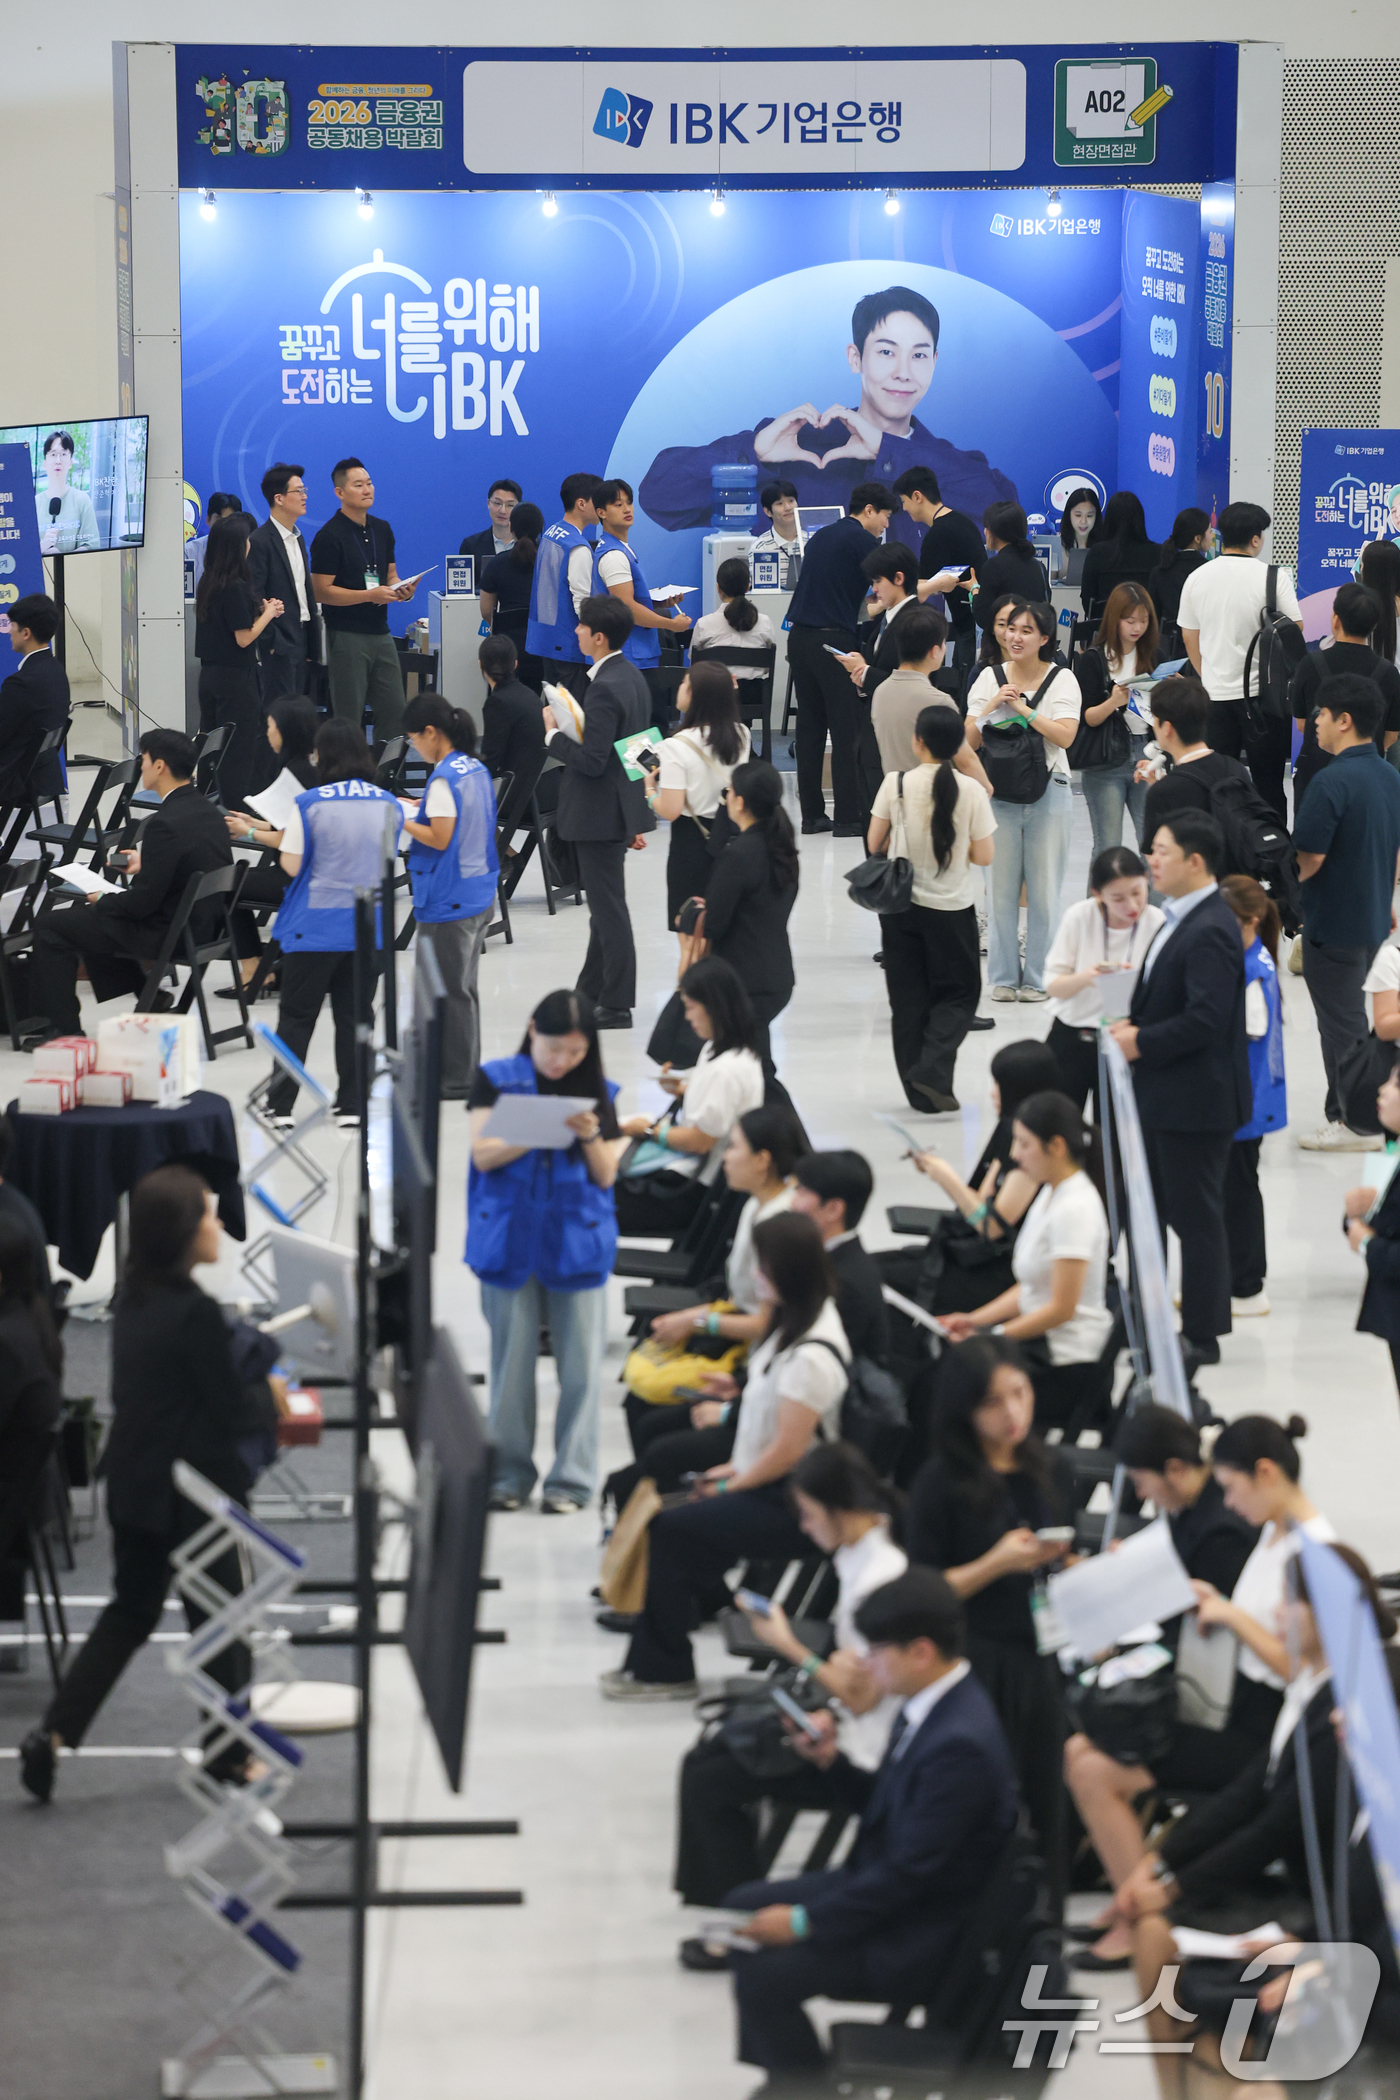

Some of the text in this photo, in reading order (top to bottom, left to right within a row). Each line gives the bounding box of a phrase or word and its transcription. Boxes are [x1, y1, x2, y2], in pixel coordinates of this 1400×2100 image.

[308, 100, 443, 125] 2026 금융권
[1084, 90, 1125, 113] A02
[307, 127, 443, 149] 공동채용 박람회
[1072, 143, 1137, 159] 현장면접관
[1145, 246, 1162, 269] 꿈꾸고
[1142, 276, 1153, 298] 오직
[1153, 278, 1164, 300] 너를
[1205, 261, 1227, 296] 금융권
[279, 325, 341, 361] 꿈꾸고
[443, 278, 539, 353] 위해
[282, 352, 529, 439] 도전하는 IBK
[1204, 371, 1225, 439] 10
[1315, 496, 1335, 509] 꿈꾸고
[1315, 510, 1345, 523] 도전하는
[1321, 559, 1338, 568] 오직
[1328, 548, 1352, 557] 꿈꾸고
[318, 778, 385, 798] STAFF
